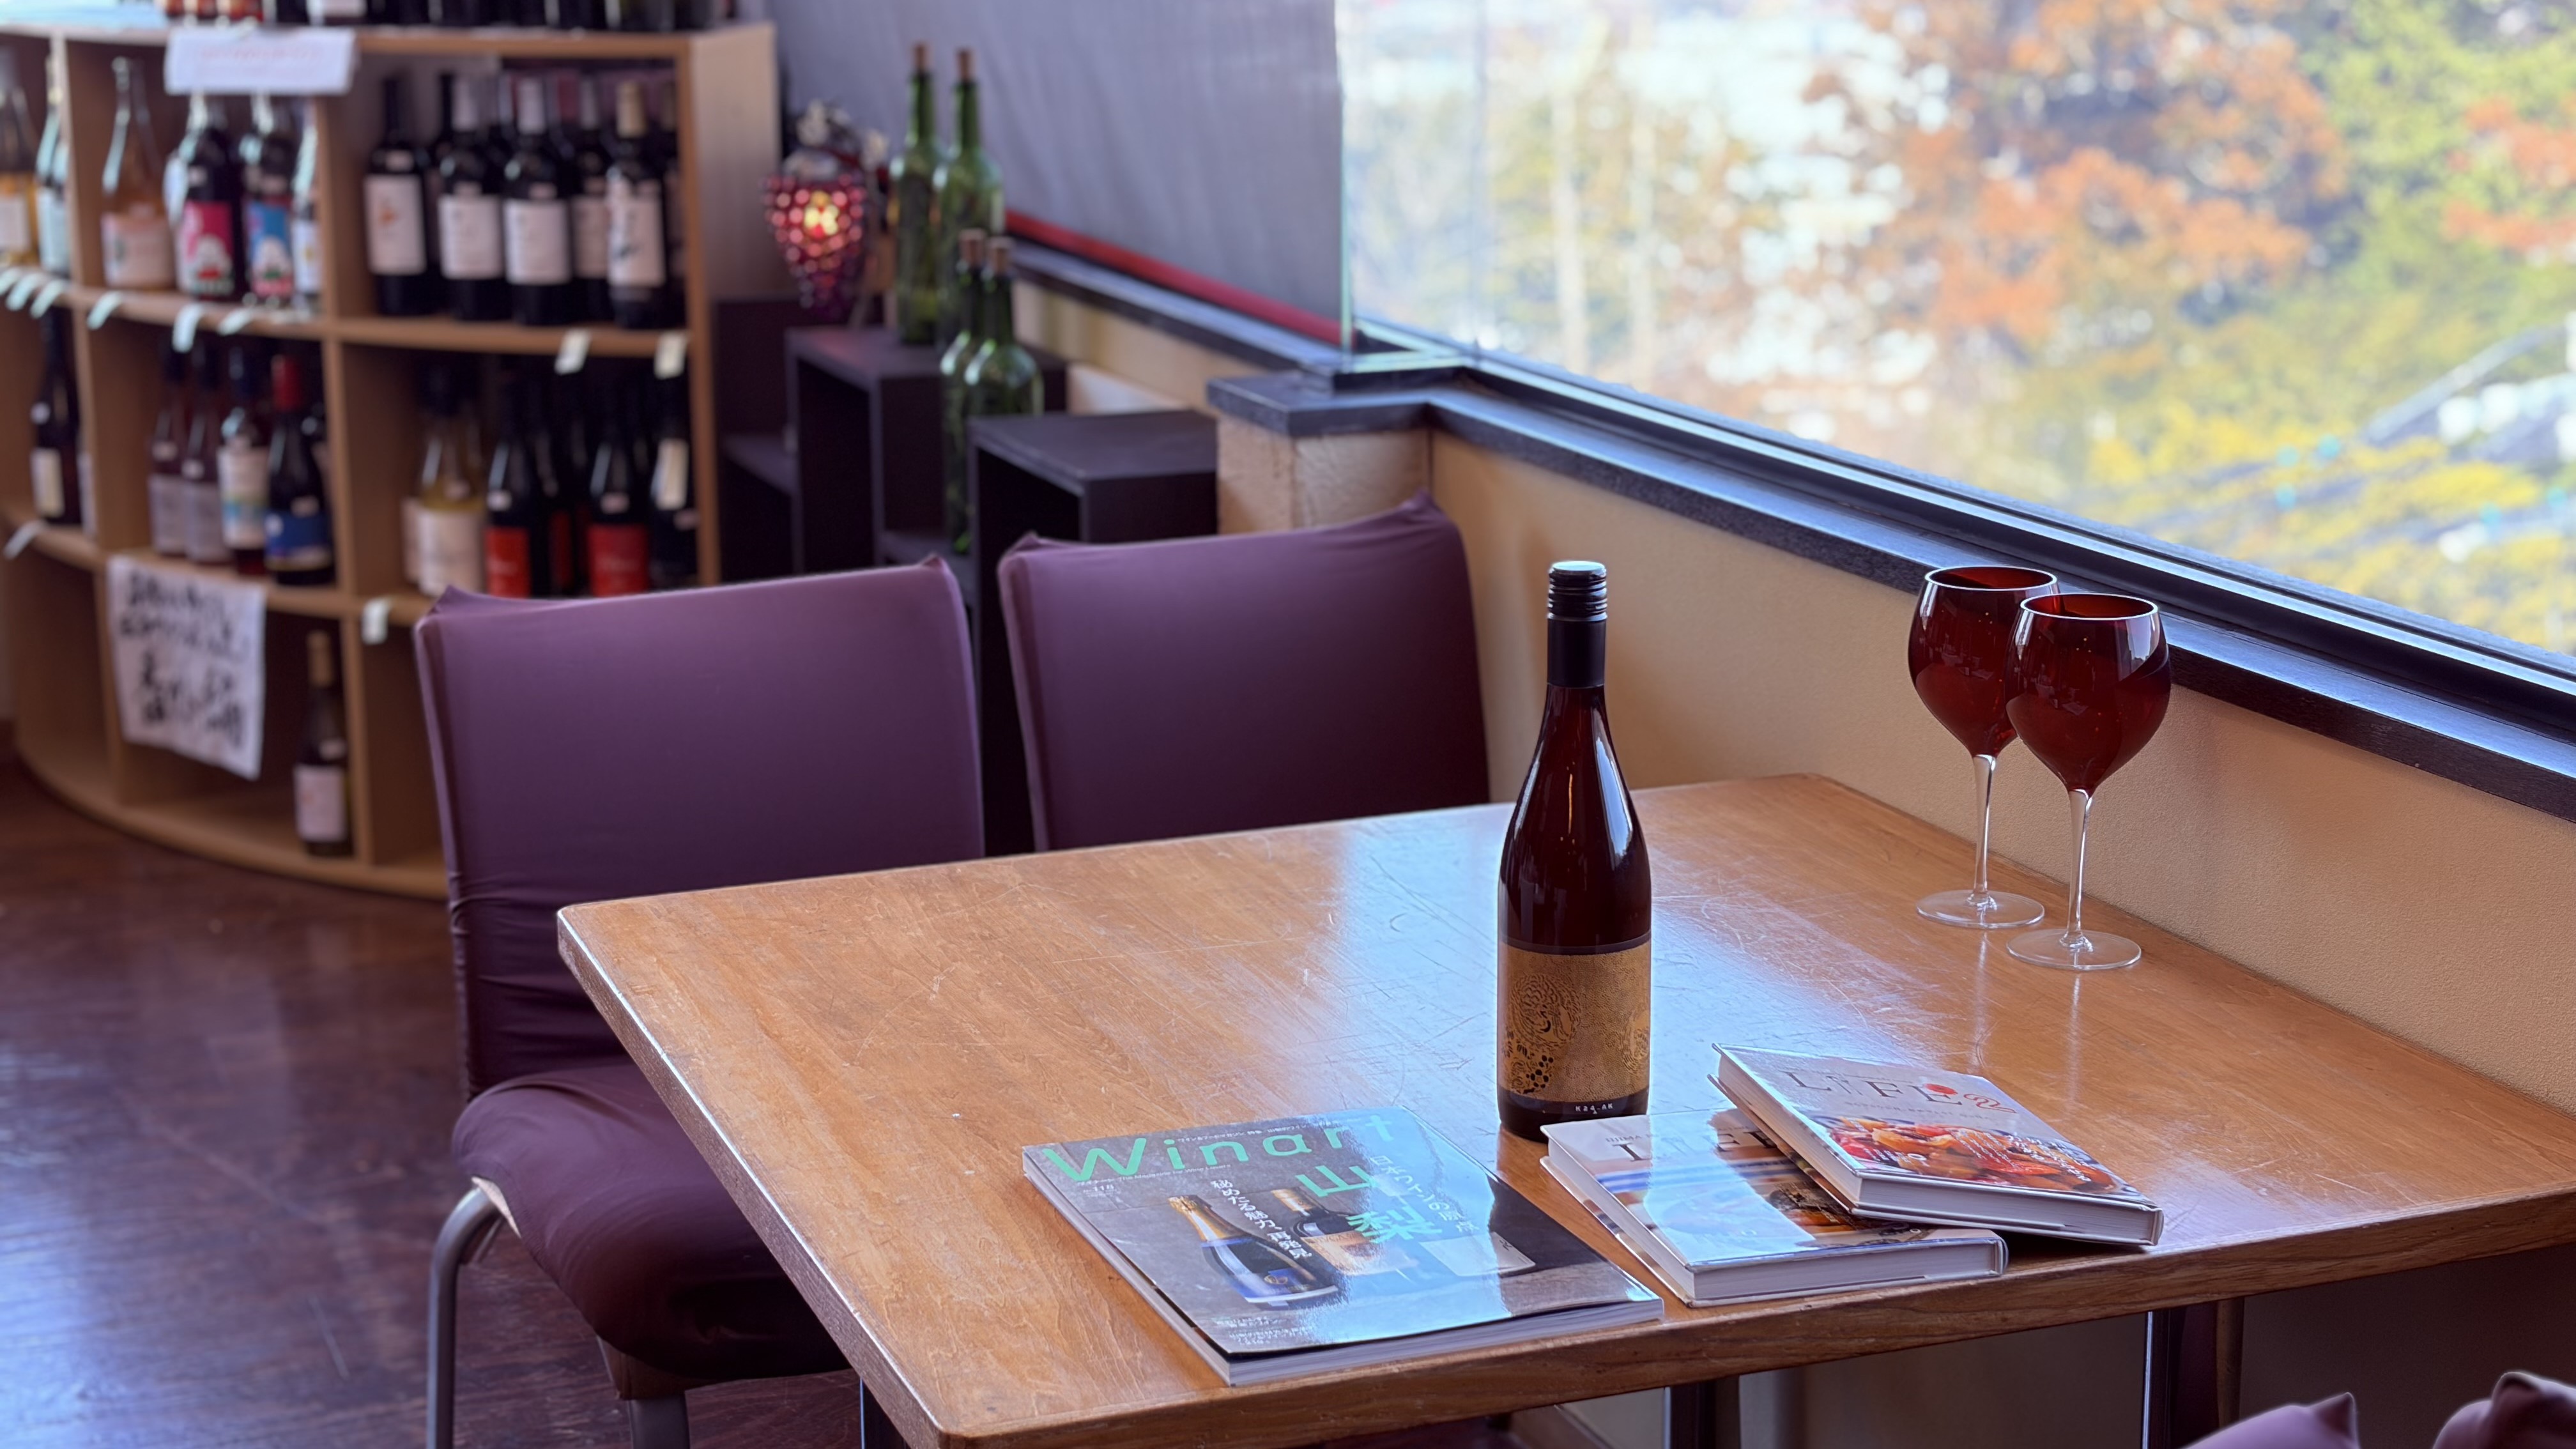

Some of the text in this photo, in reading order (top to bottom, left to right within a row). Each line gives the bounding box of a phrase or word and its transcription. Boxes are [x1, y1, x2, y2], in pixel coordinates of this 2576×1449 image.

[1042, 1115, 1394, 1181] Winart
[1210, 1179, 1313, 1260] 秘めたる魅力、再発見
[1294, 1165, 1442, 1243] 山梨
